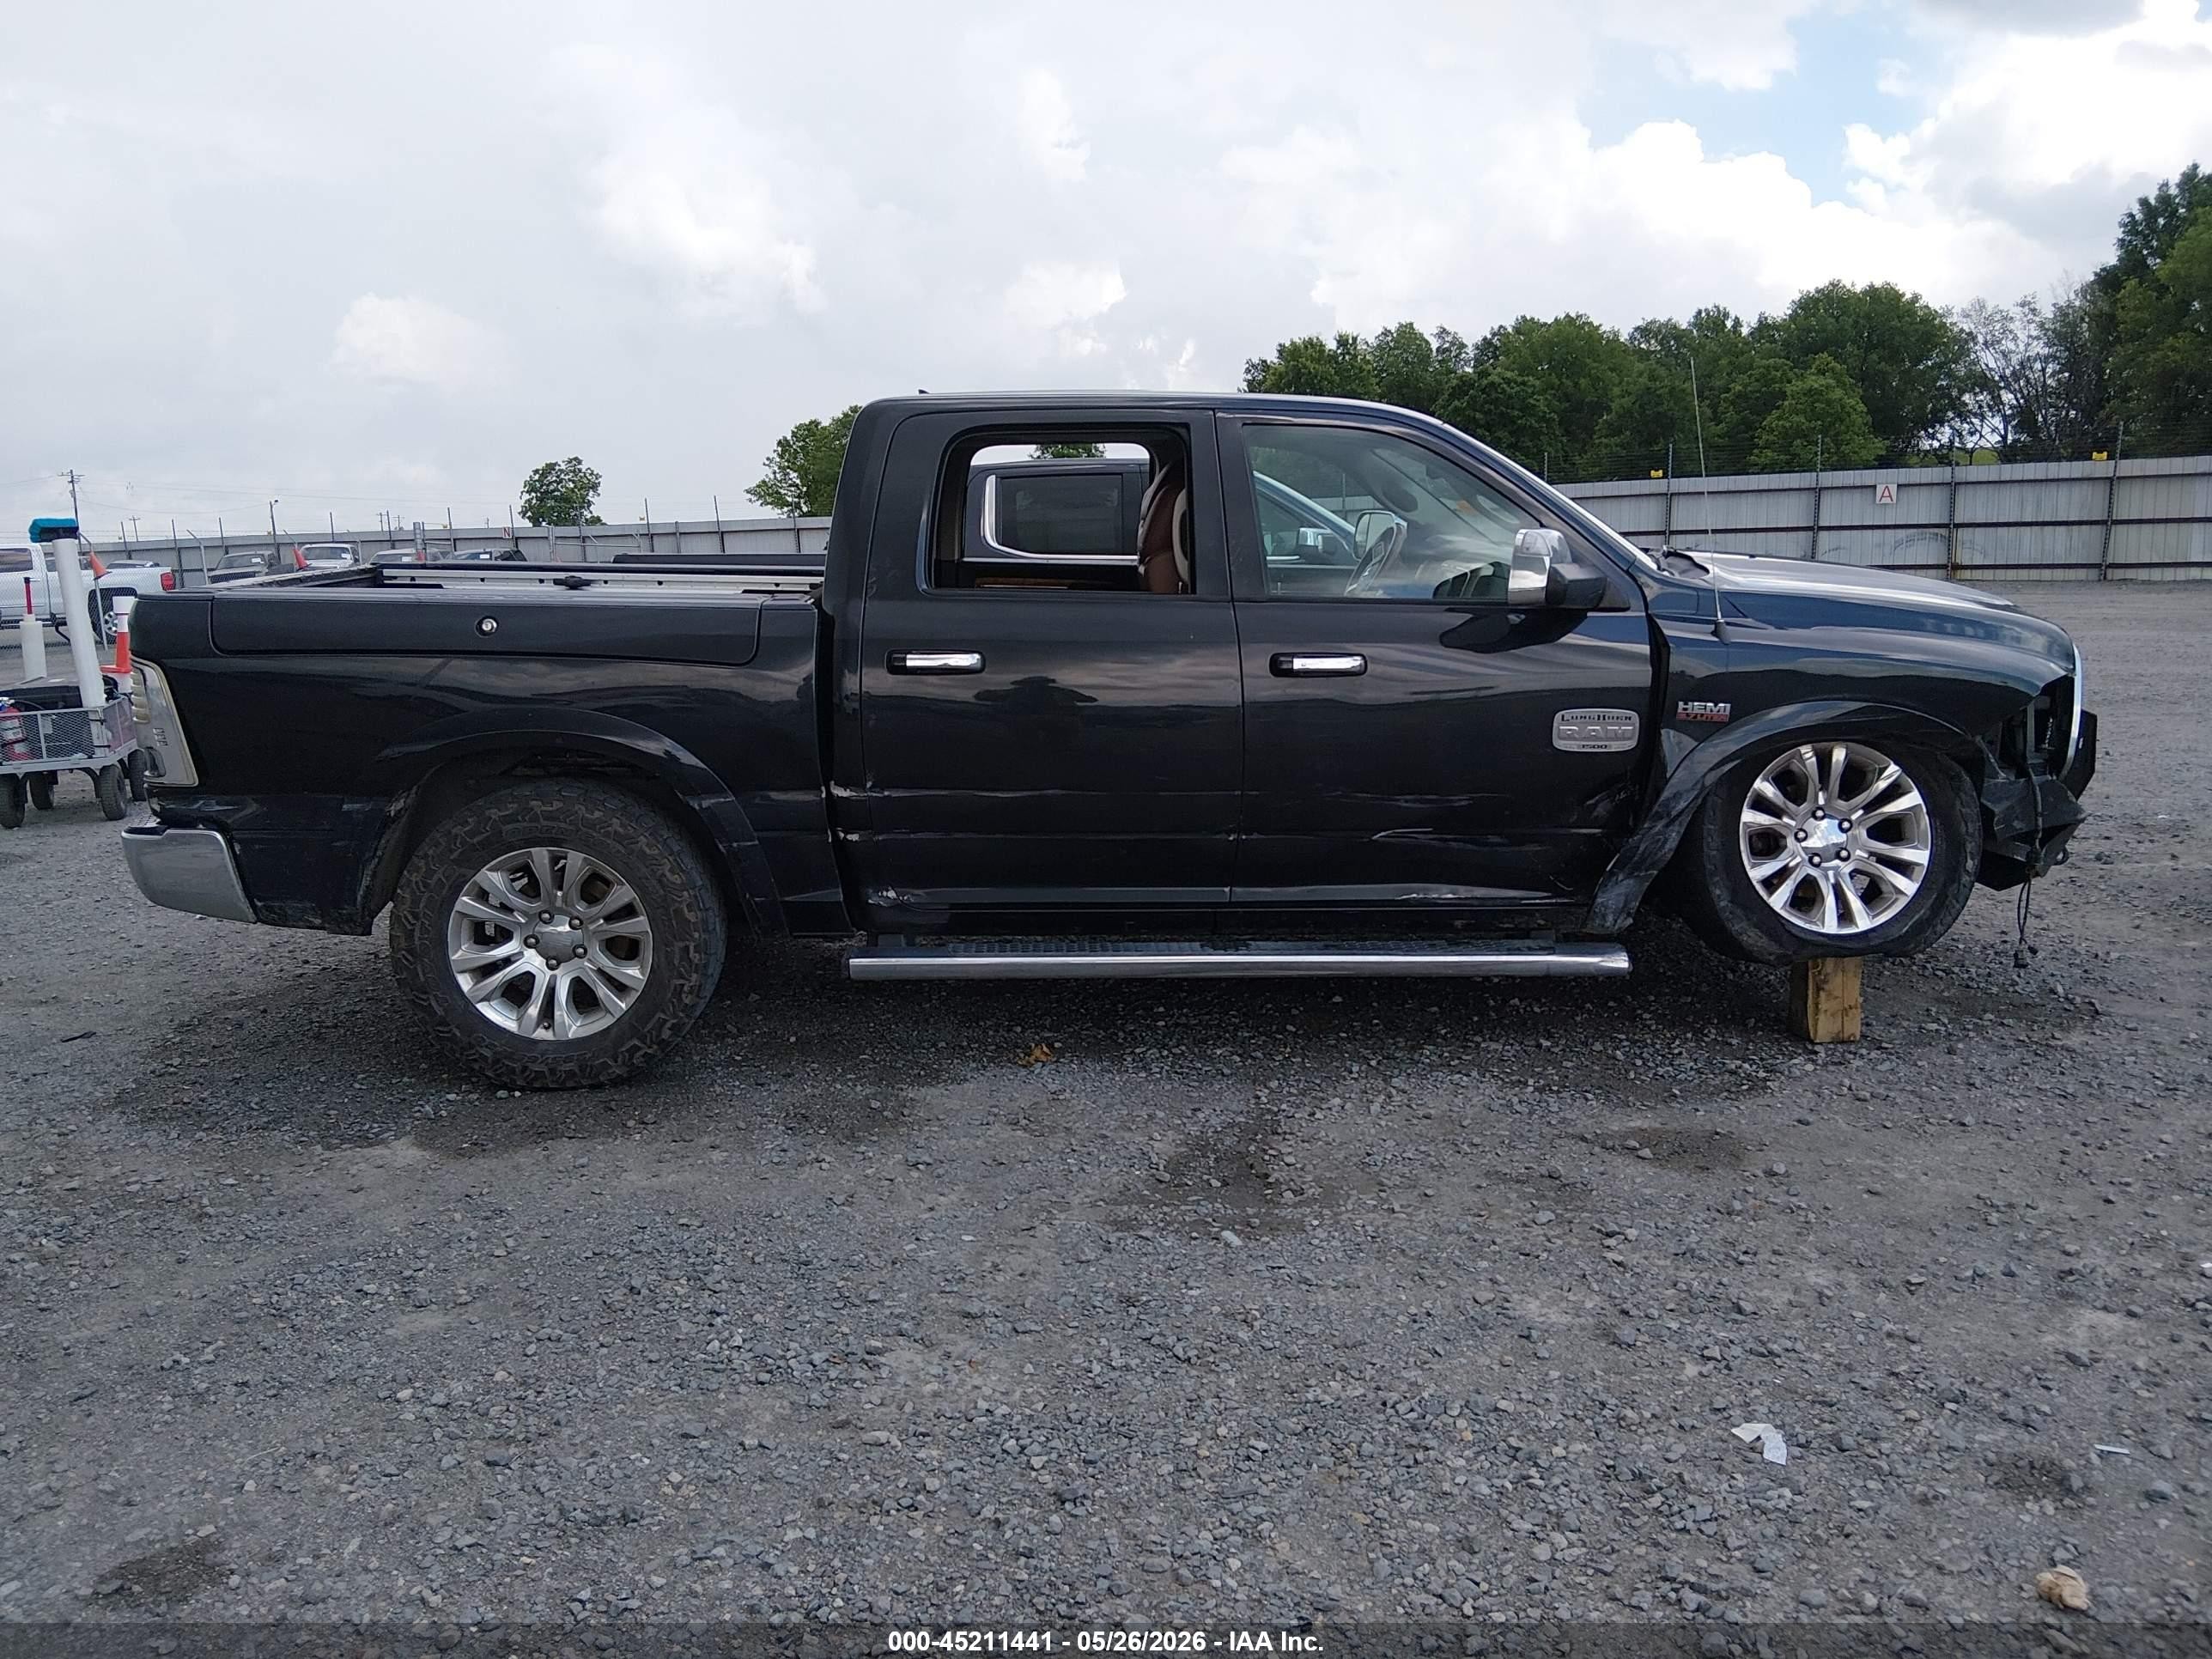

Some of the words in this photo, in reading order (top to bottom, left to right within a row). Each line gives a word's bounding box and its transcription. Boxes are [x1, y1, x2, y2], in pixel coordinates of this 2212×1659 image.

[1879, 484, 1893, 502] A
[503, 526, 511, 538] N
[1677, 701, 1731, 714] HEMI
[1559, 725, 1634, 740] RAM
